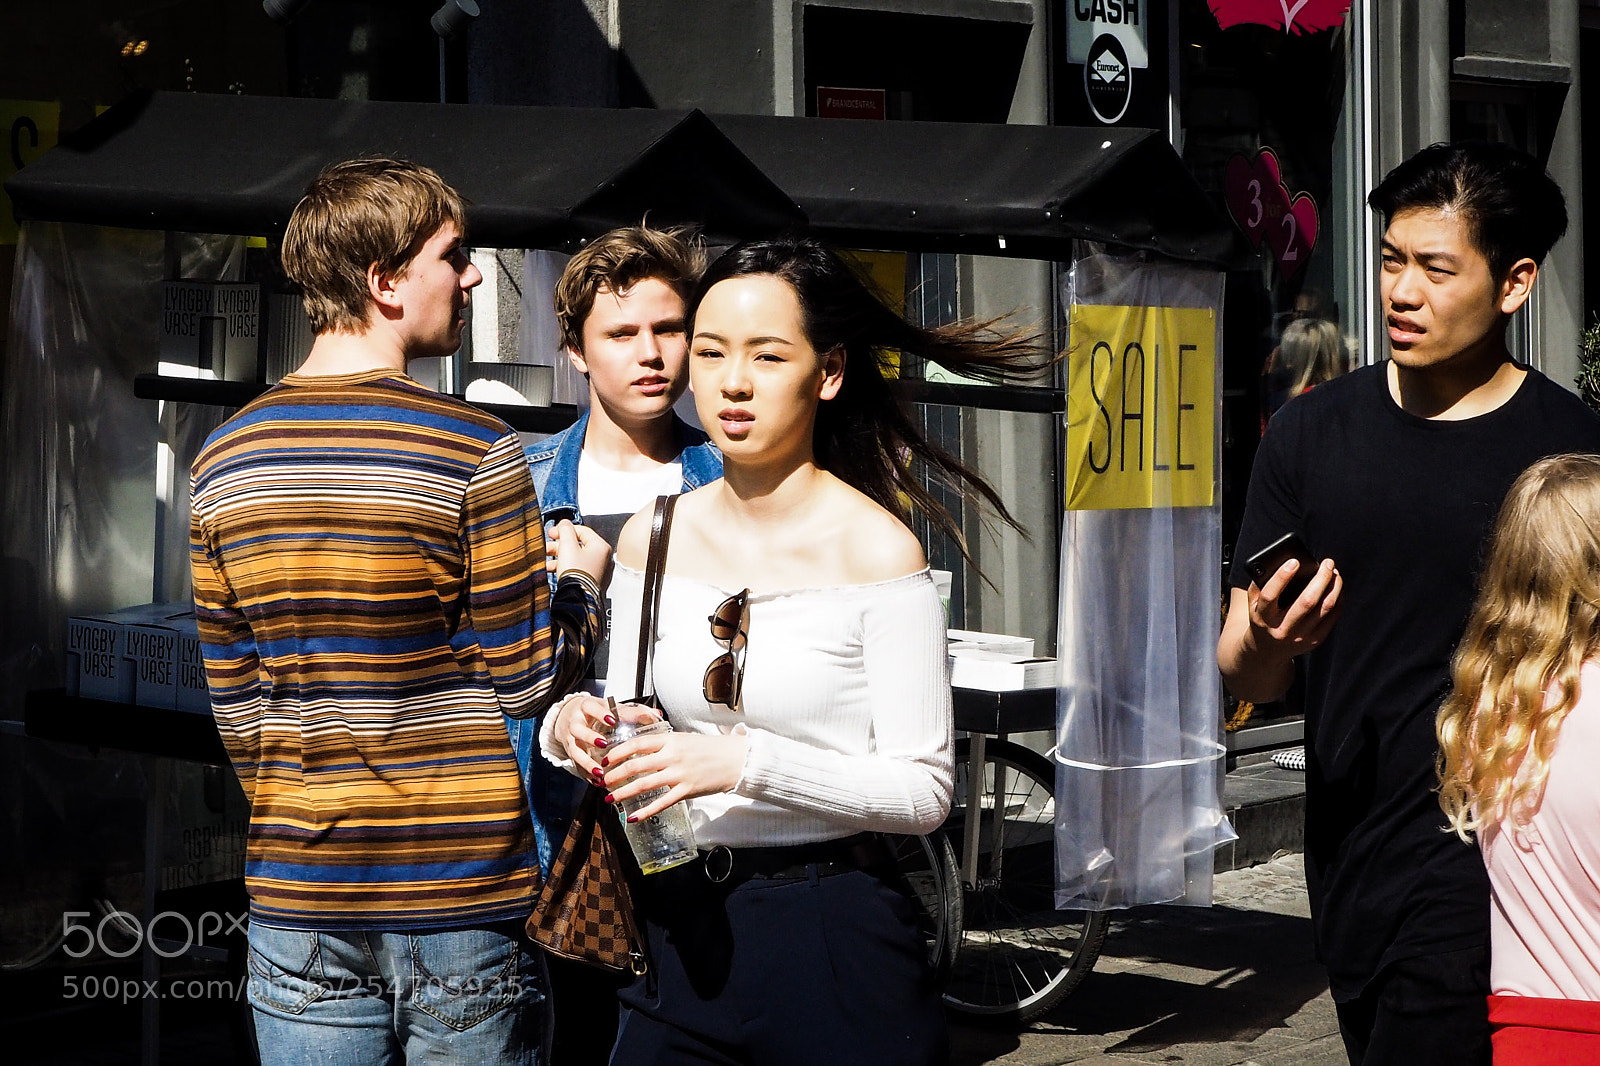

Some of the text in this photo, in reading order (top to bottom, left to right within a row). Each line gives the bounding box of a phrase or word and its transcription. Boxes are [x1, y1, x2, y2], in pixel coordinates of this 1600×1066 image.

[1075, 0, 1139, 25] CASH
[1096, 60, 1120, 72] Euronet
[1247, 179, 1263, 228] 3
[1281, 212, 1298, 261] 2
[164, 287, 212, 313] LYNGBY
[217, 289, 258, 313] LYNGBY
[164, 311, 197, 337] VASE
[229, 314, 257, 337] VASE
[1088, 341, 1198, 474] SALE
[70, 624, 116, 653] LYNGBY
[127, 631, 174, 660] LYNGBY
[182, 638, 203, 664] LYN
[84, 651, 115, 679] VASE
[141, 658, 173, 685] VASE
[181, 663, 209, 691] VAS
